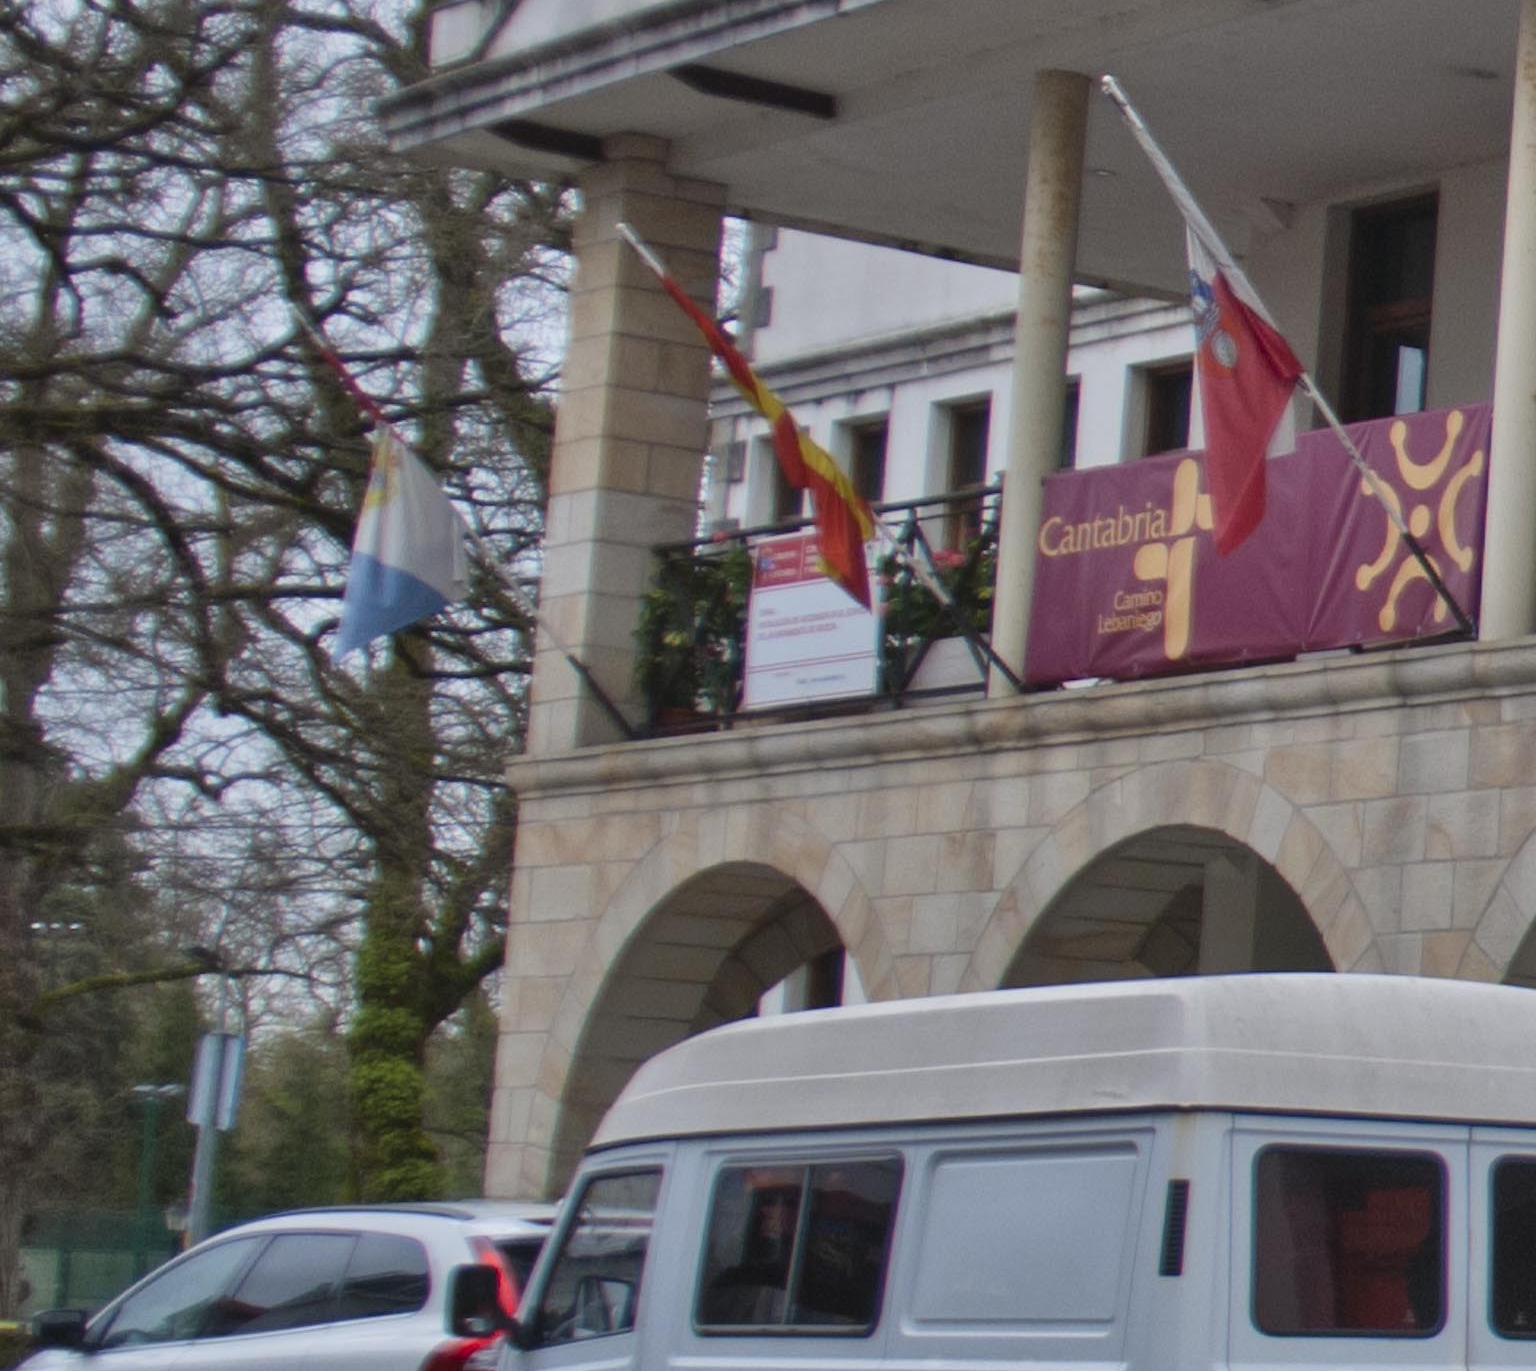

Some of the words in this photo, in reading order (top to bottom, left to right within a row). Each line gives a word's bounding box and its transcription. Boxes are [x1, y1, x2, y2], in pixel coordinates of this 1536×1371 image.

[1039, 502, 1167, 557] Cantabria
[1114, 589, 1163, 611] Camino
[1097, 610, 1163, 635] Lebaniego
